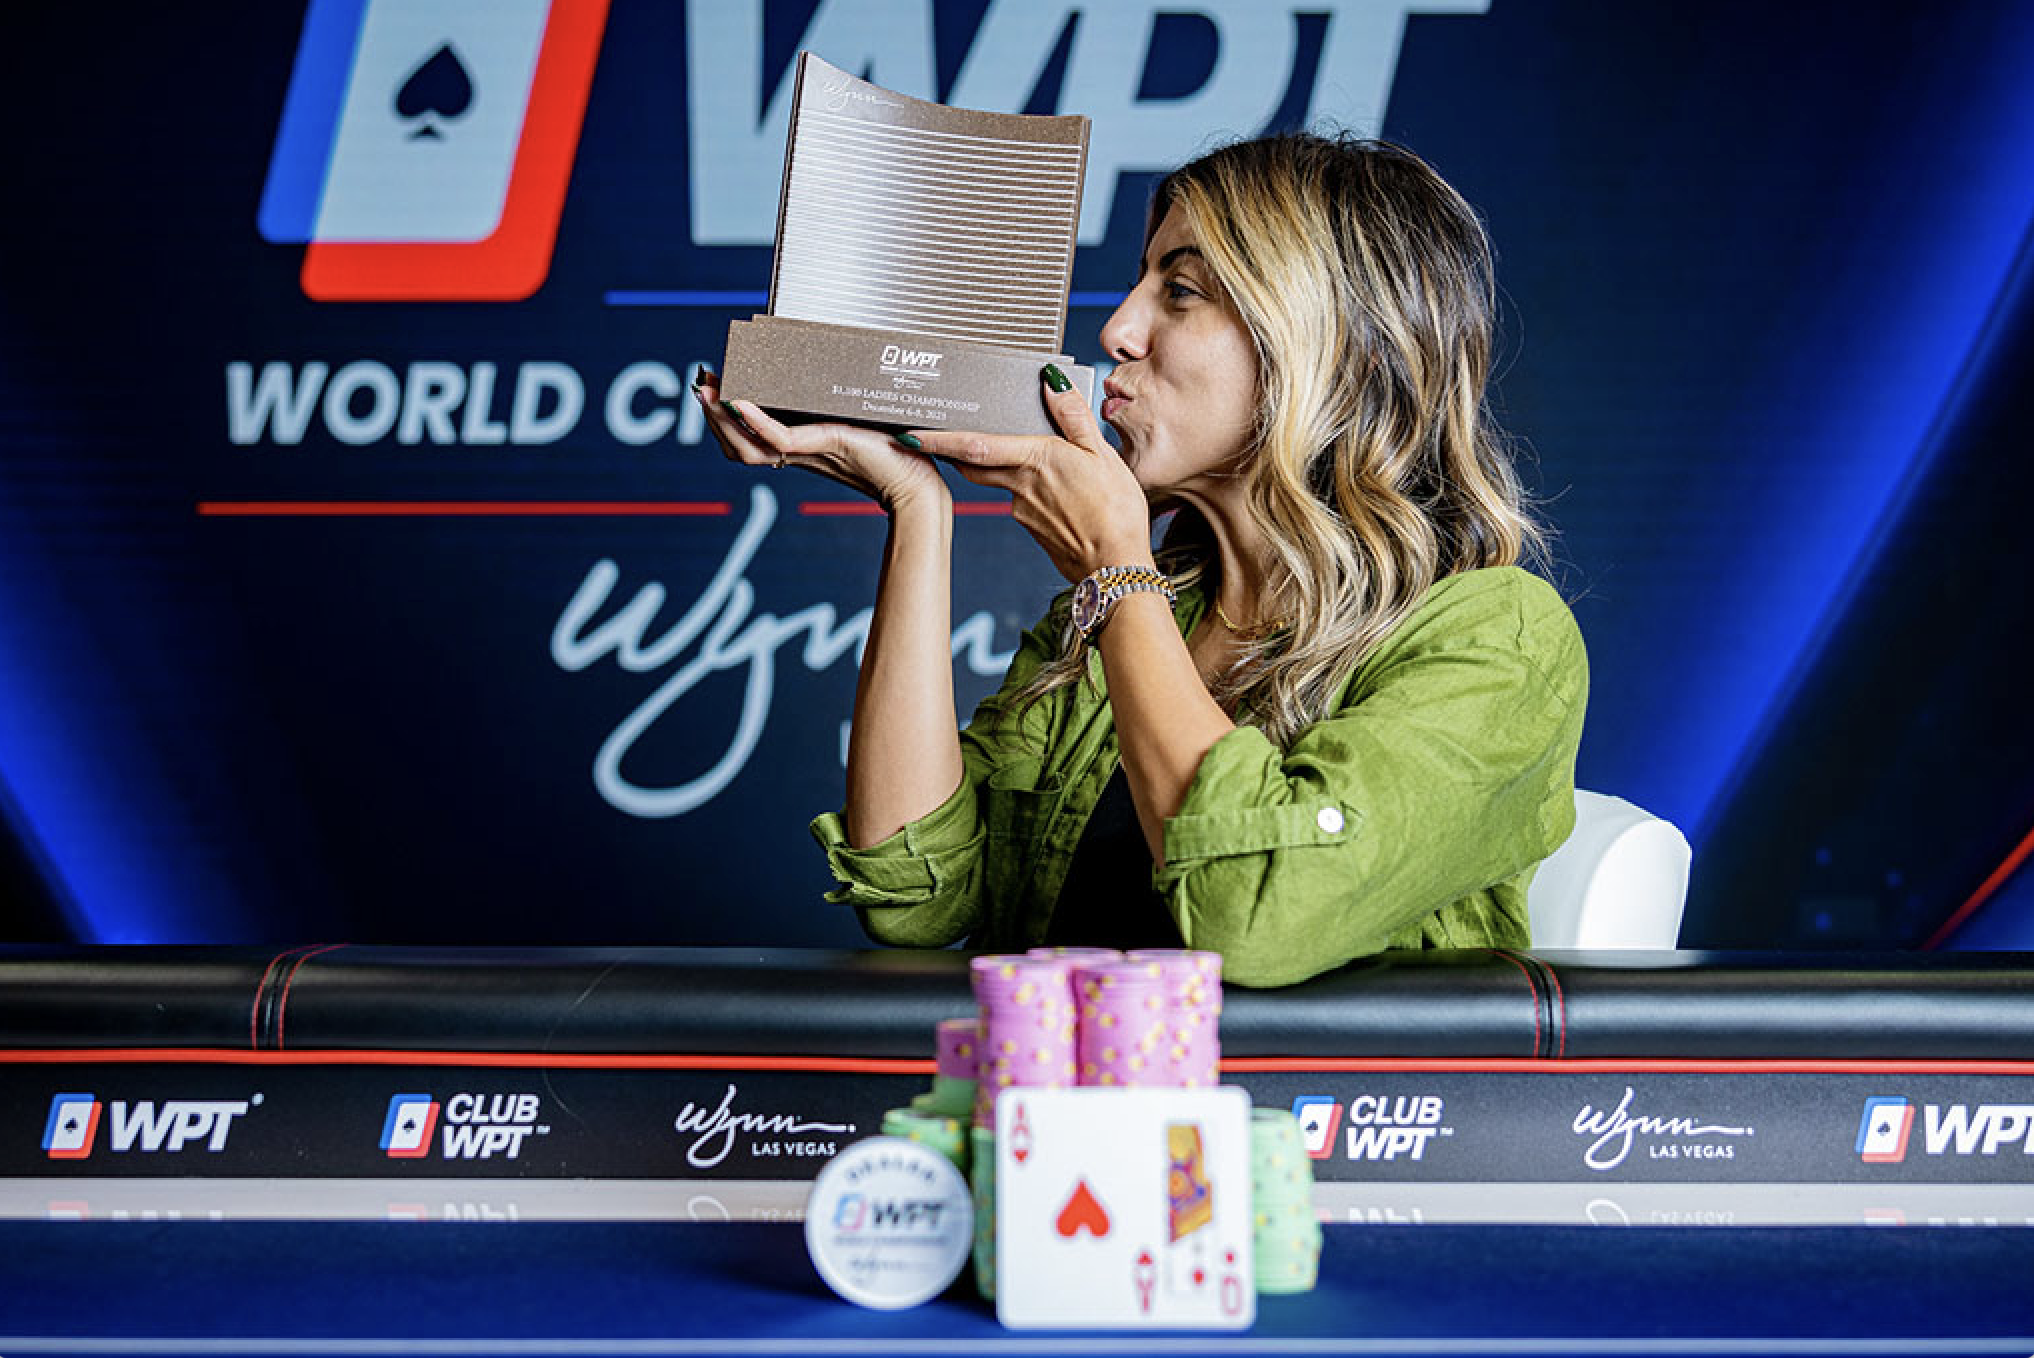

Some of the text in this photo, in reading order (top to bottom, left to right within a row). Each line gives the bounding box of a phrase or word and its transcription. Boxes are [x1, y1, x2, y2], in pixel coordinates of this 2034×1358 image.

[901, 349, 943, 367] WPT
[226, 360, 586, 445] WORLD
[861, 400, 906, 415] December
[863, 387, 899, 401] LADIES
[899, 392, 981, 412] CHAMPIONSHIP
[446, 1093, 541, 1124] CLUB
[1351, 1095, 1444, 1125] CLUB
[111, 1101, 249, 1152] WPT
[443, 1125, 534, 1158] WPT
[752, 1142, 837, 1156] LAS VEGAS
[1347, 1127, 1437, 1161] WPT
[1650, 1145, 1735, 1159] LAS VEGAS
[872, 1198, 950, 1229] WPT
